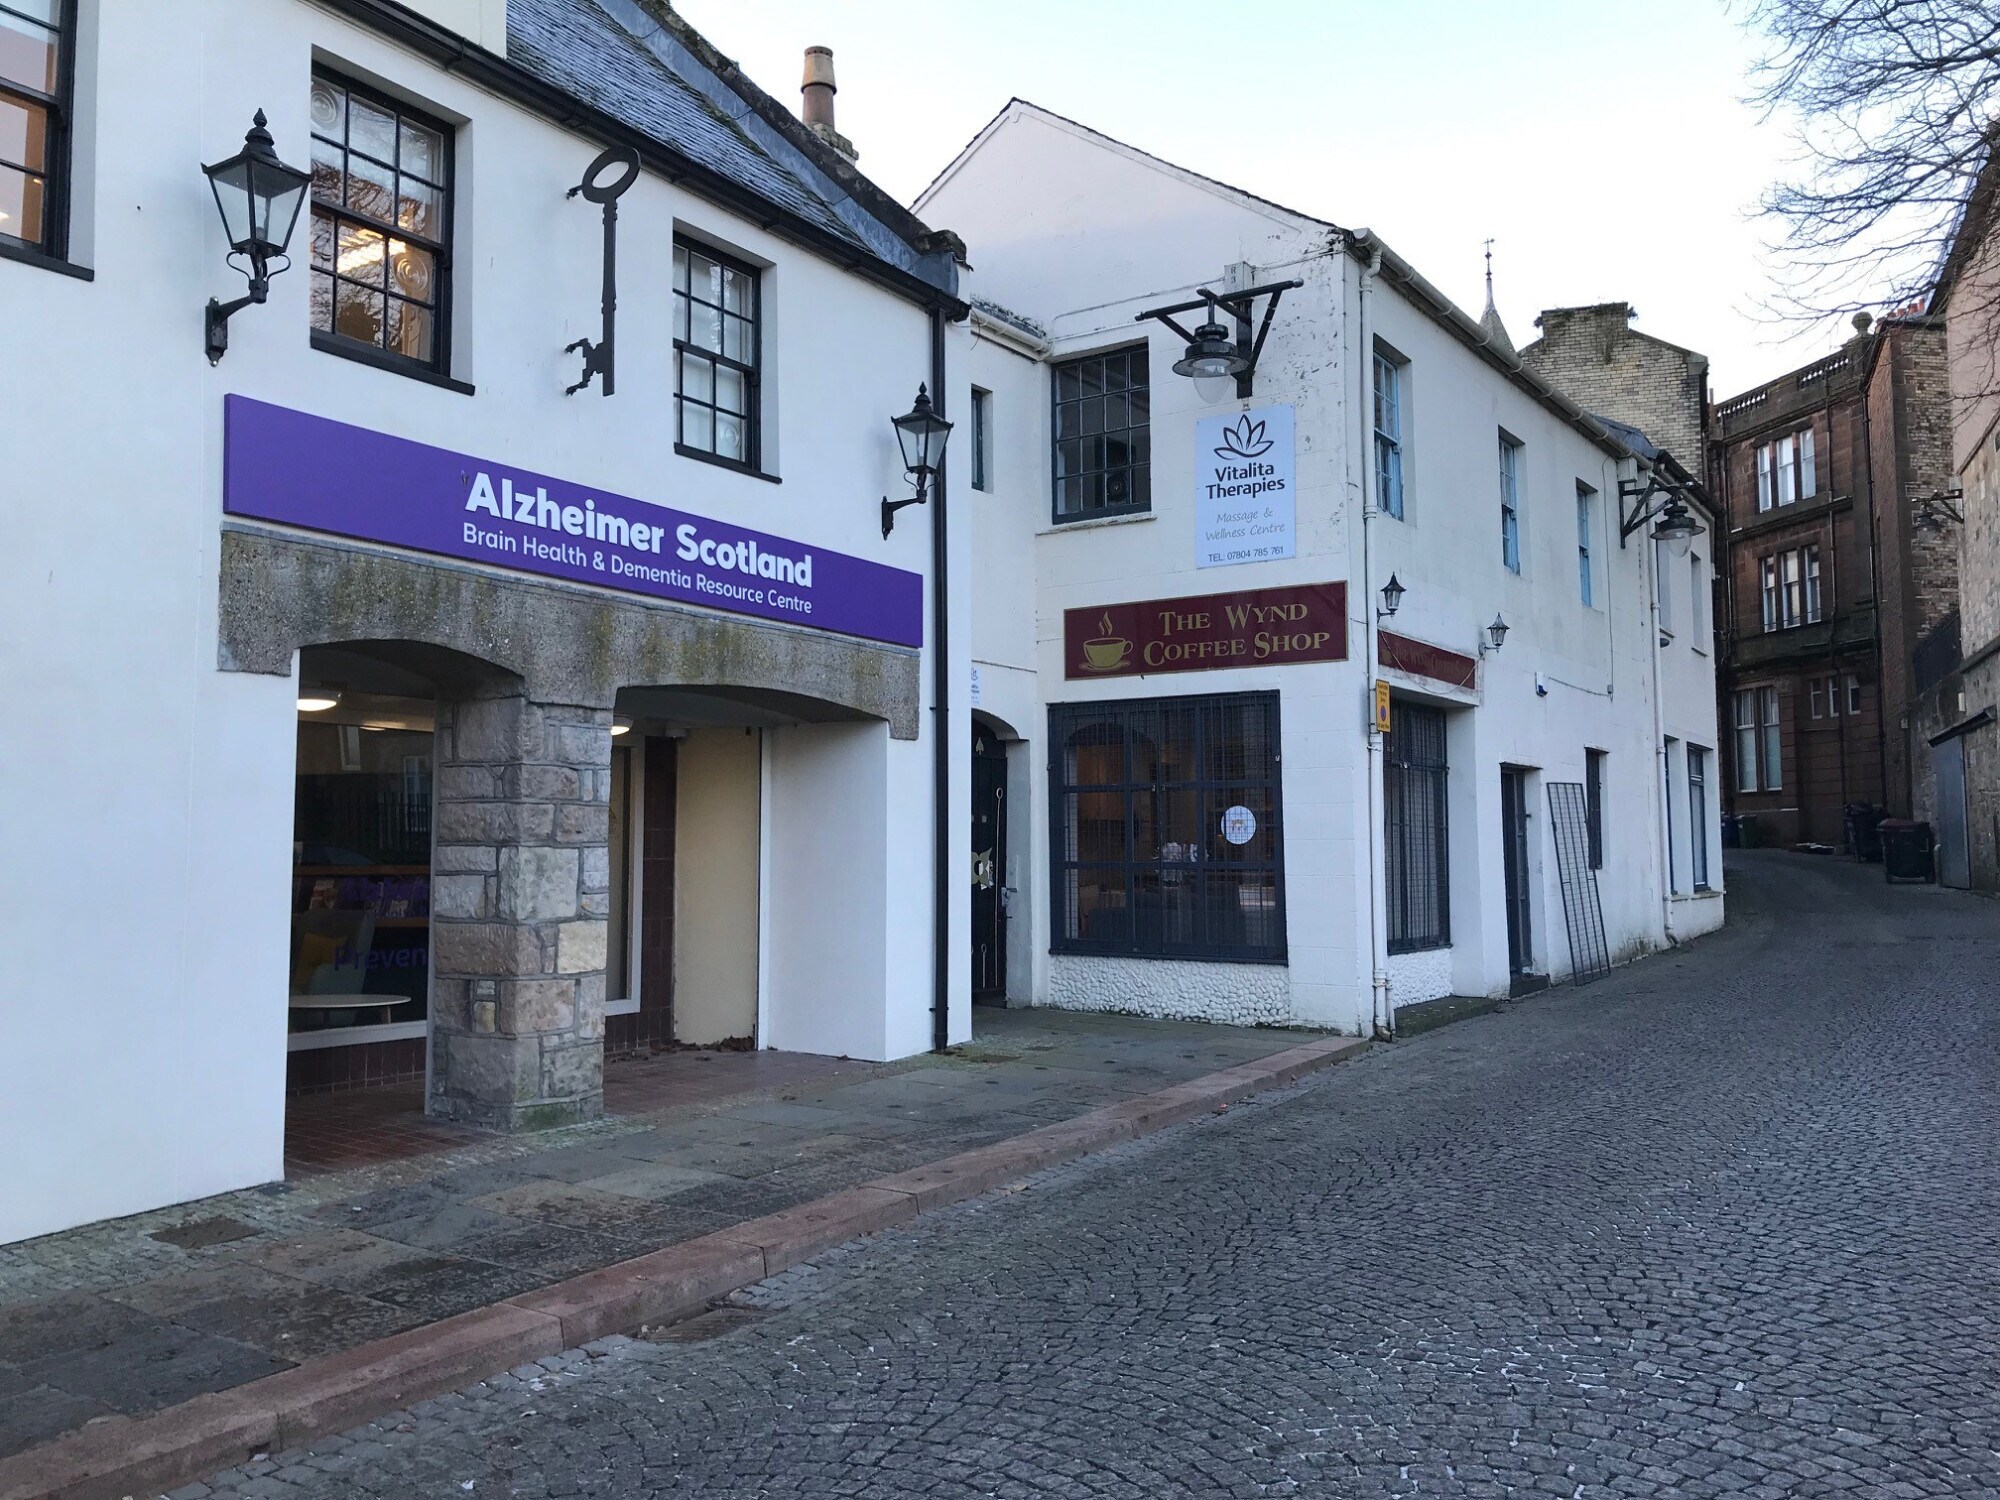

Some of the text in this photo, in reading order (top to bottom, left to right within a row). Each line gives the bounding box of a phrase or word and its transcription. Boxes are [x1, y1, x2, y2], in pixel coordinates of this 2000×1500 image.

[1214, 462, 1275, 482] Vitalita
[1205, 477, 1286, 499] Therapies
[1216, 507, 1274, 523] Massage &
[464, 471, 813, 588] Alzheimer Scotland
[1205, 523, 1285, 541] Wellness Centre
[1208, 545, 1284, 562] TEL: 07804 785 761
[463, 522, 813, 614] Brain Health & Dementia Resource Centre
[1159, 603, 1309, 636] THE WYND
[1143, 631, 1330, 667] COFFEE SHOP
